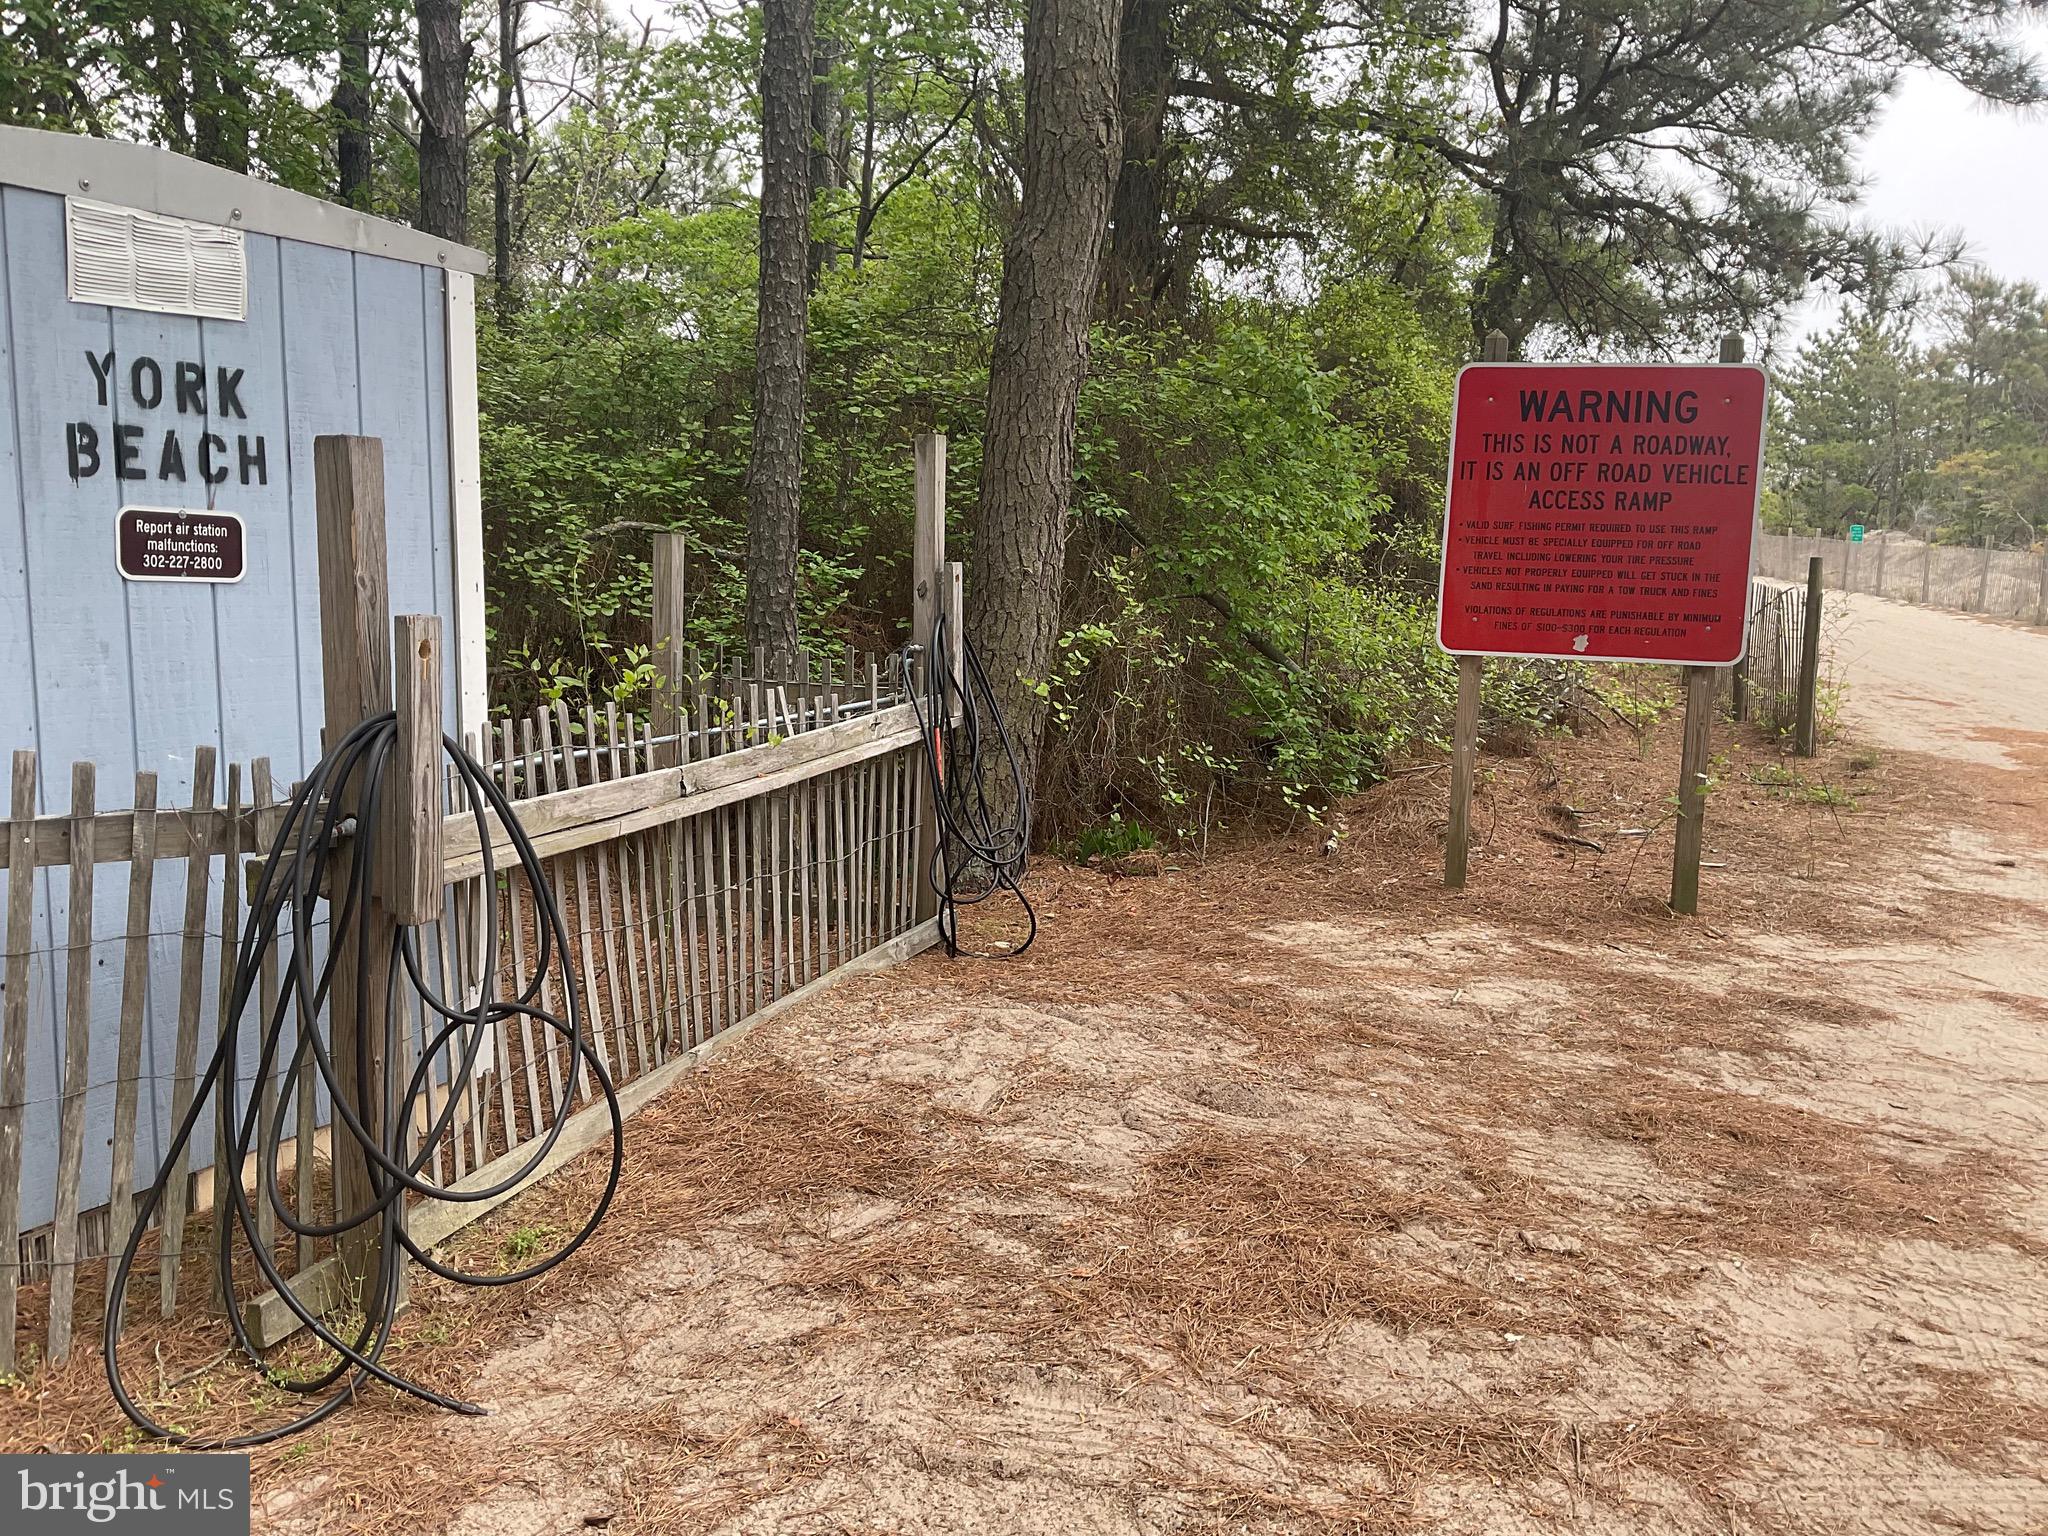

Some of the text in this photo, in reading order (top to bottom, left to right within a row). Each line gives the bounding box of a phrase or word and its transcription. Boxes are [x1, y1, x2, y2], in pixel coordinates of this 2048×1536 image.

[85, 350, 248, 419] YORK
[1520, 390, 1699, 424] WARNING
[1482, 433, 1732, 459] THIS IS NOT A ROADWAY,
[66, 422, 268, 488] BEACH
[1460, 461, 1749, 484] IT IS AN OFF ROAD VEHICLE
[1529, 490, 1672, 511] ACCESS RAMP
[136, 520, 228, 538] Report air station
[1466, 521, 1718, 535] VALID SURF FISHING PERMIT REQUIRED TO USE THIS RAMP
[147, 538, 219, 553] malfunctions:
[1465, 536, 1701, 550] VEHICLE MUST BE SPECIALLY EQUIPPED FOR OFF ROAD
[143, 555, 223, 571] 302-227-2800
[1473, 552, 1694, 566] TRAVEL INCLUDING LOWERING YOUR TIRE PRESSURE
[1463, 567, 1720, 582] VEHICLES NOT PROPERLY EQUIPPED WILL GET STUCK IN THE
[1471, 581, 1718, 598] SAND RESULTING IN PAYING FOR A TOW TRUCK AND FINES
[1465, 606, 1721, 623] VIOLATIONS OF REGULATIONS ARE PUNISHABLE BY MINIMUM
[1495, 621, 1517, 630] FINES
[1521, 622, 1532, 631] OF
[1589, 625, 1605, 633] FOR
[1609, 626, 1631, 635] EACH
[1634, 627, 1687, 637] REGULATION
